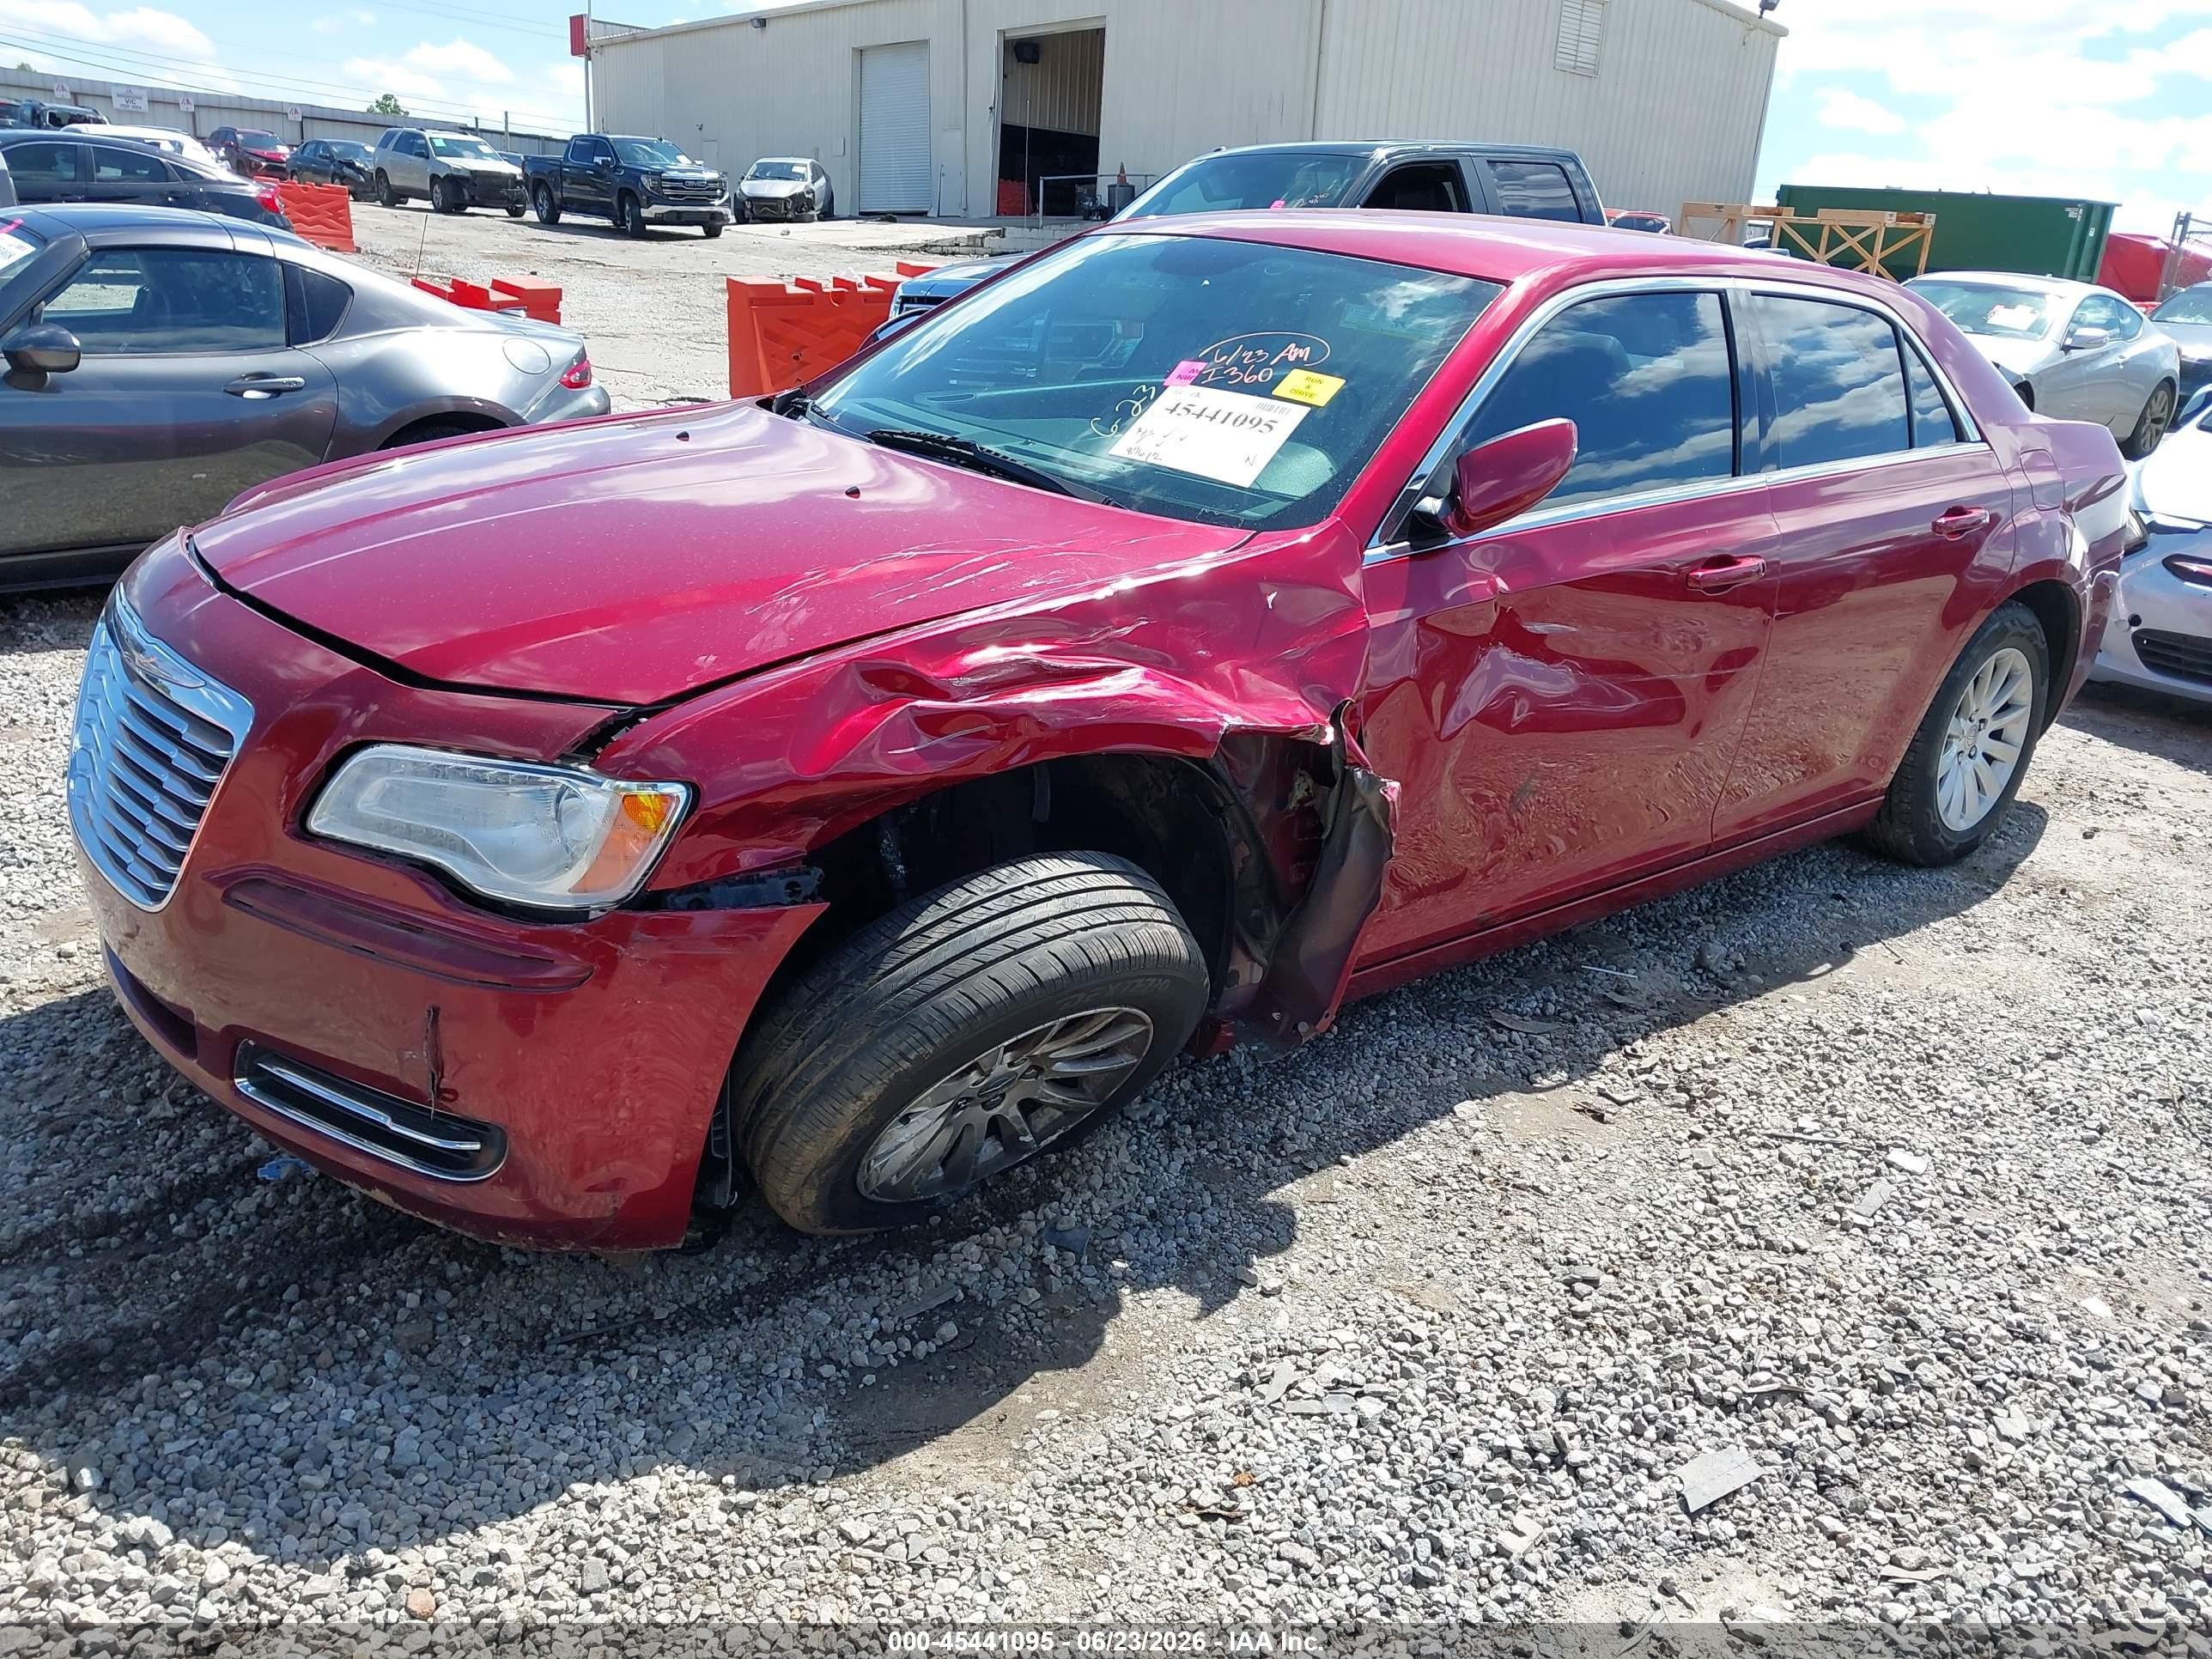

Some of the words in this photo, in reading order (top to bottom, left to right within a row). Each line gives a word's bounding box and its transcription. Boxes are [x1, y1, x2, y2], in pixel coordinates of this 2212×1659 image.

[1214, 344, 1269, 365] 6/23
[1304, 376, 1324, 385] RUN
[1165, 401, 1279, 434] 45441095
